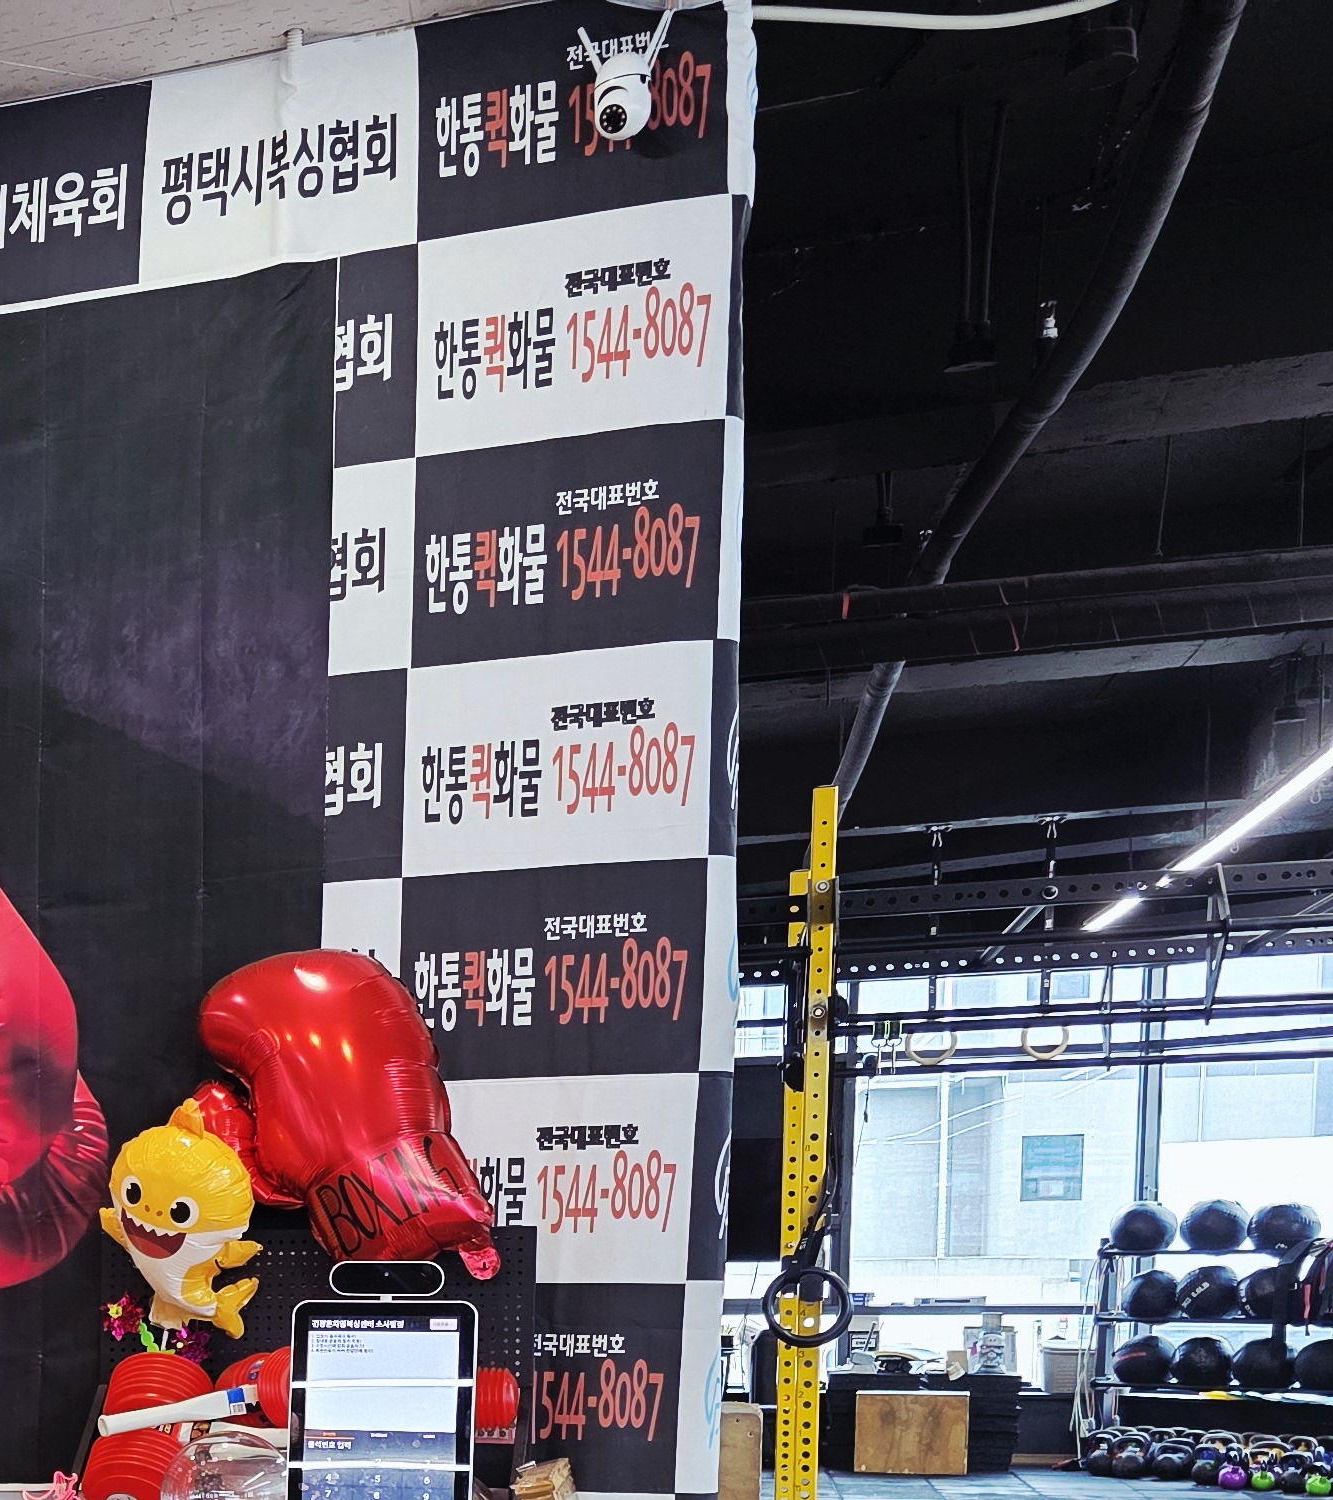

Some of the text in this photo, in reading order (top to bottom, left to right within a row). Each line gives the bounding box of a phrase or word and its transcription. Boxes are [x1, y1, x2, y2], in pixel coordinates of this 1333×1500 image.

[160, 112, 398, 226] 평택시복싱협회
[434, 79, 559, 179] 한통퀵화물
[564, 257, 671, 298] 전국대표번호
[434, 307, 554, 401] 한통퀵화물
[566, 282, 712, 383] 1544-8087
[555, 478, 660, 515] 전국대표번호
[426, 523, 548, 616] 한통퀵화물
[556, 503, 701, 601] 1544-8087
[551, 697, 656, 731] 전국대표번호
[421, 739, 542, 825] 한통퀵화물
[551, 721, 697, 816] 1544-8087
[543, 912, 648, 941] 전국대표번호
[415, 947, 536, 1032] 한통퀵화물
[544, 936, 689, 1026] 1544-8087
[535, 1124, 639, 1150] 전국대표번호
[315, 1134, 460, 1259] BOXING
[536, 1150, 677, 1234] 1544-8087
